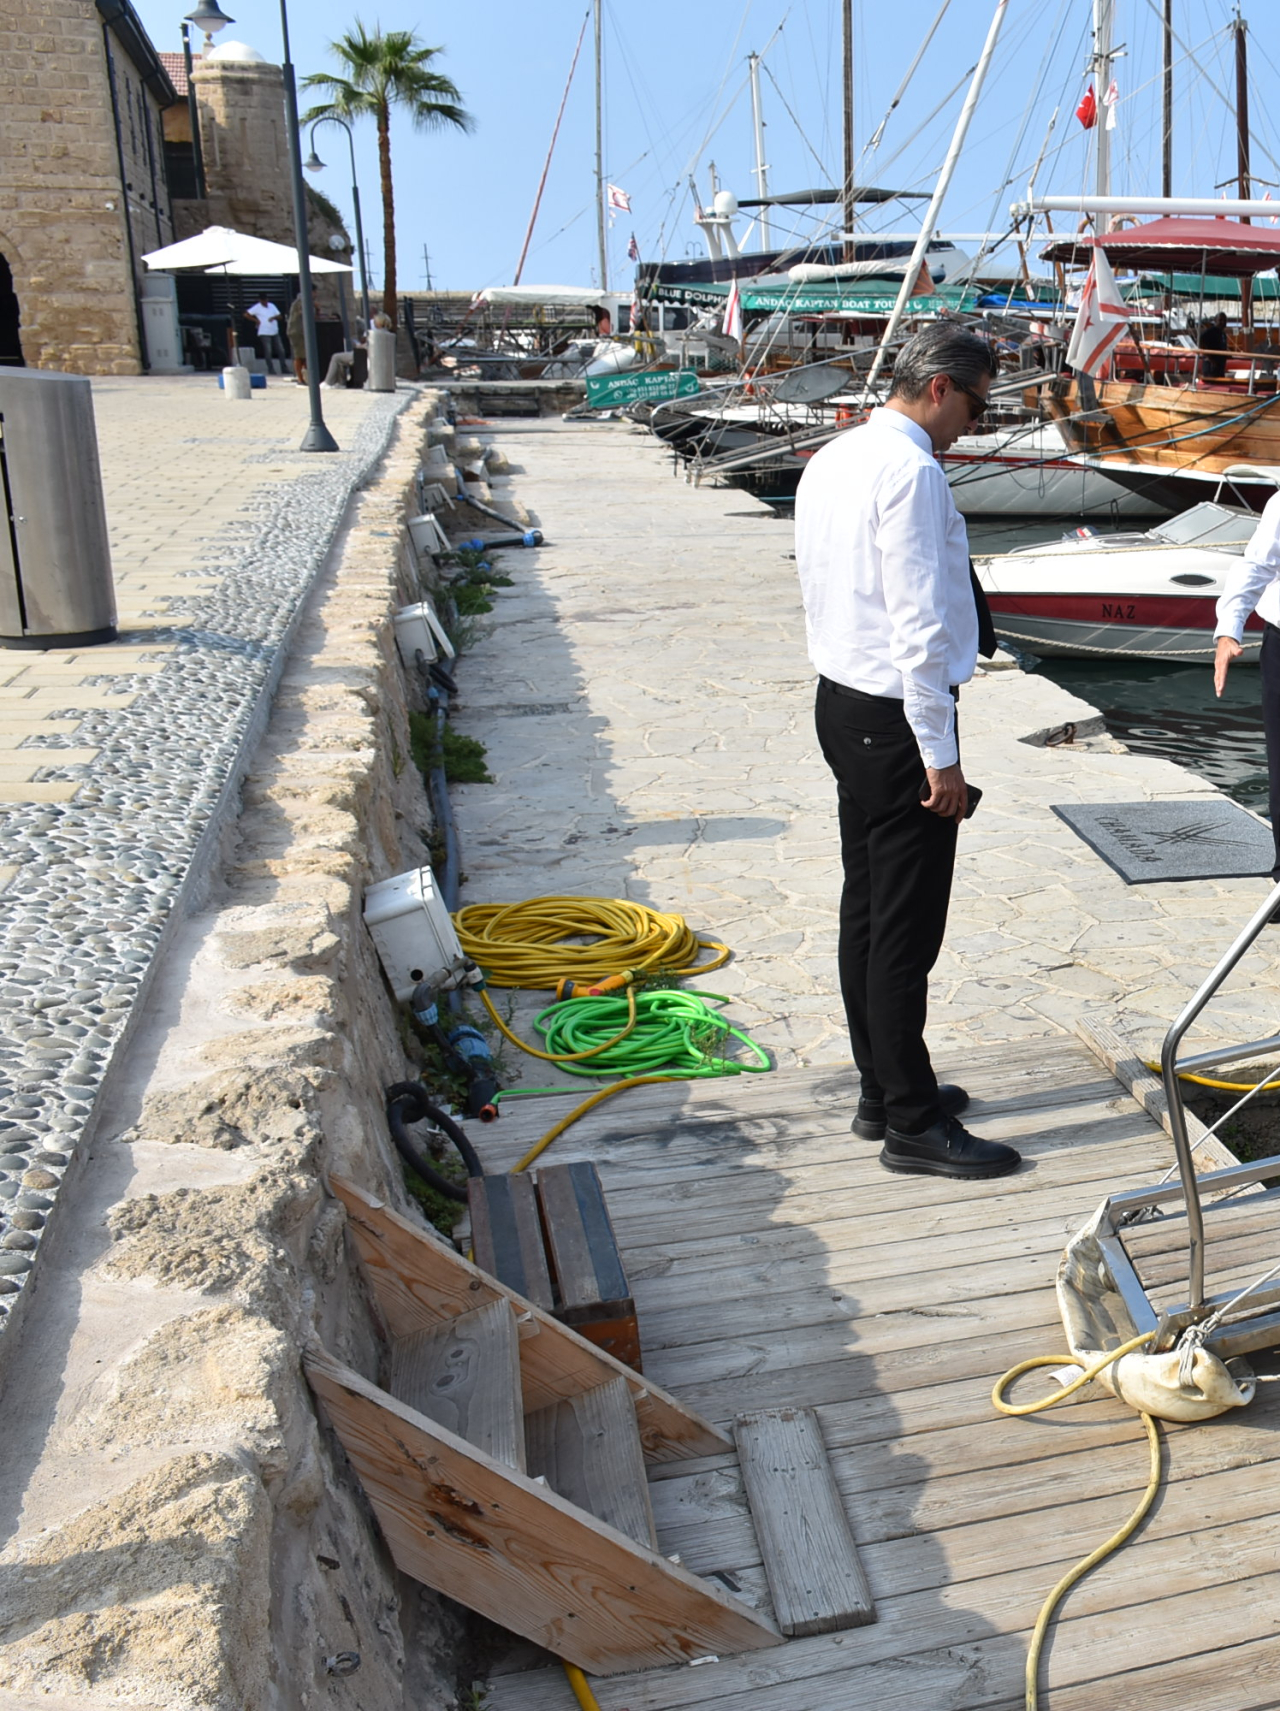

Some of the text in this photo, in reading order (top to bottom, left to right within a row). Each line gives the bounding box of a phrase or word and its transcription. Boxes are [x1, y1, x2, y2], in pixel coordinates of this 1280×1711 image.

[658, 287, 682, 299] BLUE
[795, 298, 839, 309] KAPTAN
[842, 299, 870, 309] BOAT
[1102, 603, 1136, 619] NAZ
